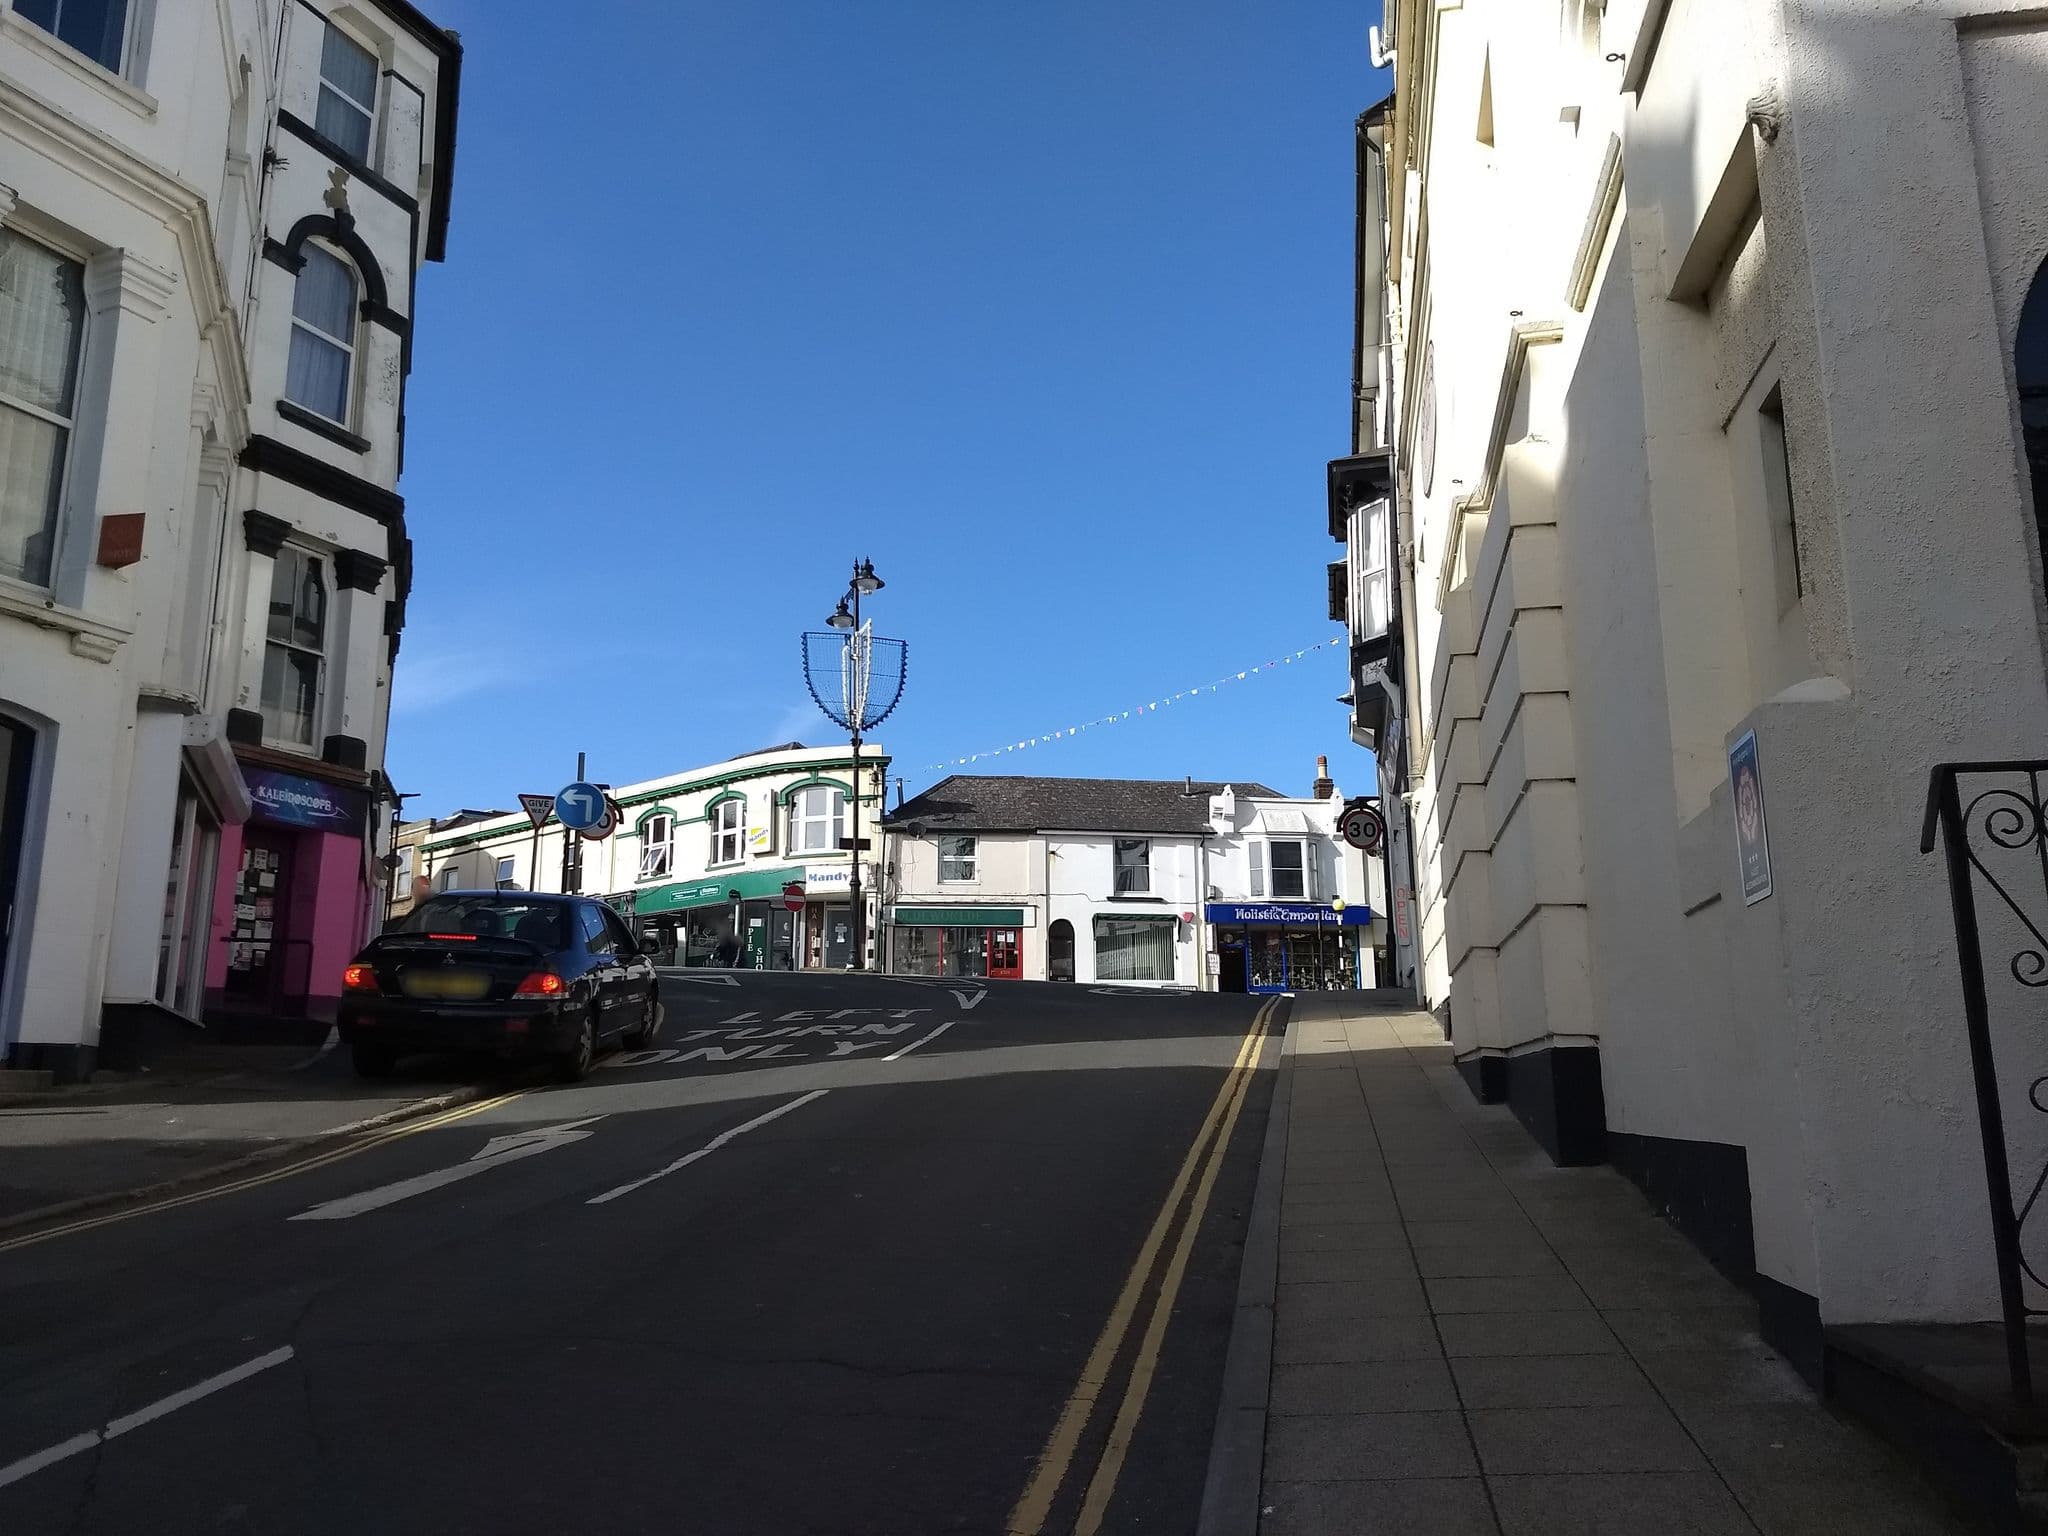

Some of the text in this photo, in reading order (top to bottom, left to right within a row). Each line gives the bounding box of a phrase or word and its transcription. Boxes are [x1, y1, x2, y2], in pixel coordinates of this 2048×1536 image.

[529, 799, 550, 808] GIVE
[1349, 822, 1376, 838] 30
[1234, 908, 1280, 921] Holistic
[1396, 888, 1408, 938] OPEN
[718, 1009, 934, 1024] LEFT
[676, 1023, 915, 1043] TURN
[598, 1041, 890, 1067] ONLY
